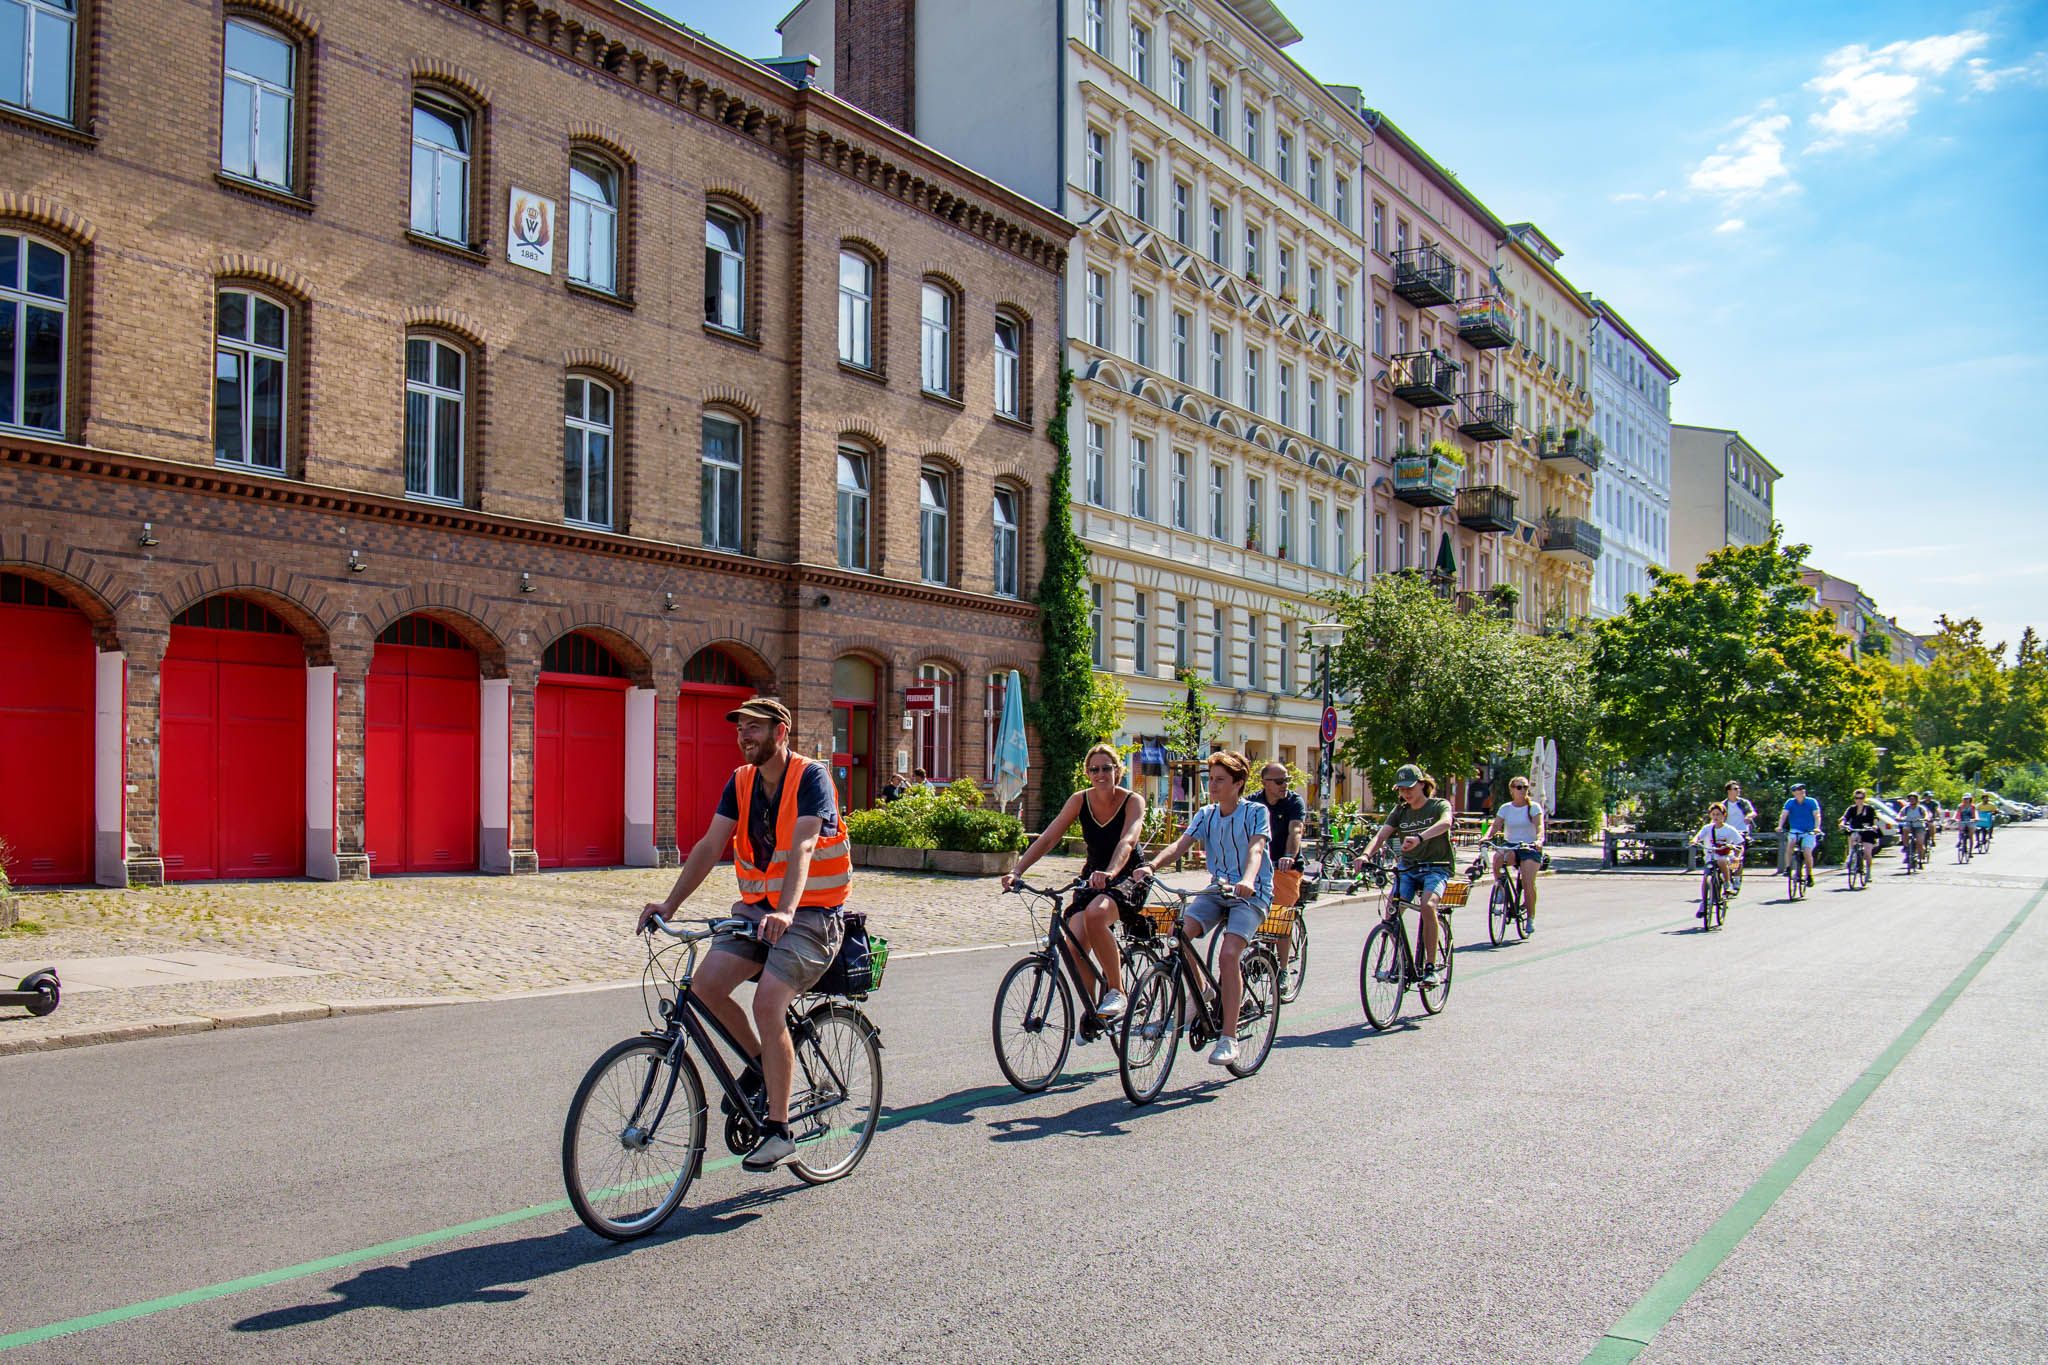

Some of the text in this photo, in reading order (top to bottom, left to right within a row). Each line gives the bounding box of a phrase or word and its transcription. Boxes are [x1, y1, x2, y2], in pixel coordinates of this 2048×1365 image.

[525, 217, 539, 234] W
[521, 249, 539, 261] 1883
[1399, 816, 1434, 829] GANT
